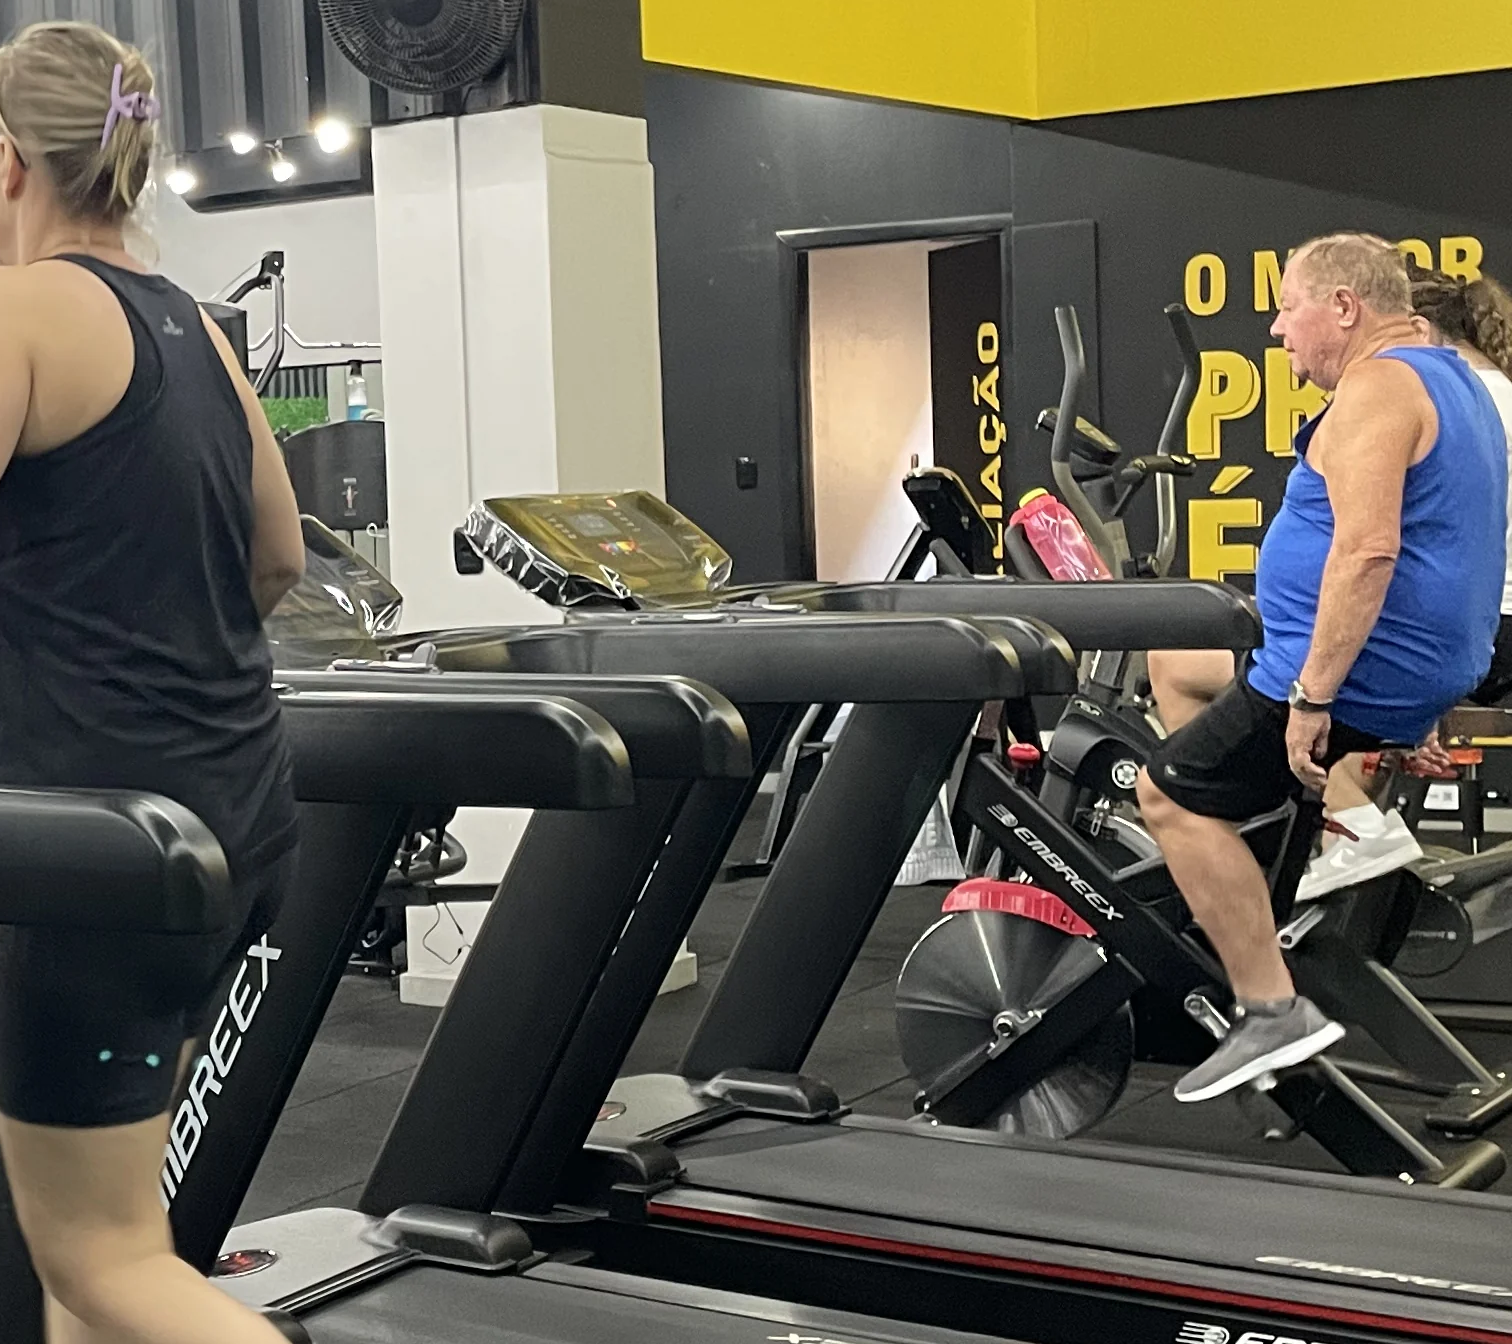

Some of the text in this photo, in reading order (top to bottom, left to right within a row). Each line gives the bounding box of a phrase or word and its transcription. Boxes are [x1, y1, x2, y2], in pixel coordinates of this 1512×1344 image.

[1185, 252, 1228, 317] O
[1012, 826, 1125, 921] EMBREEX
[158, 933, 283, 1214] MBREEX
